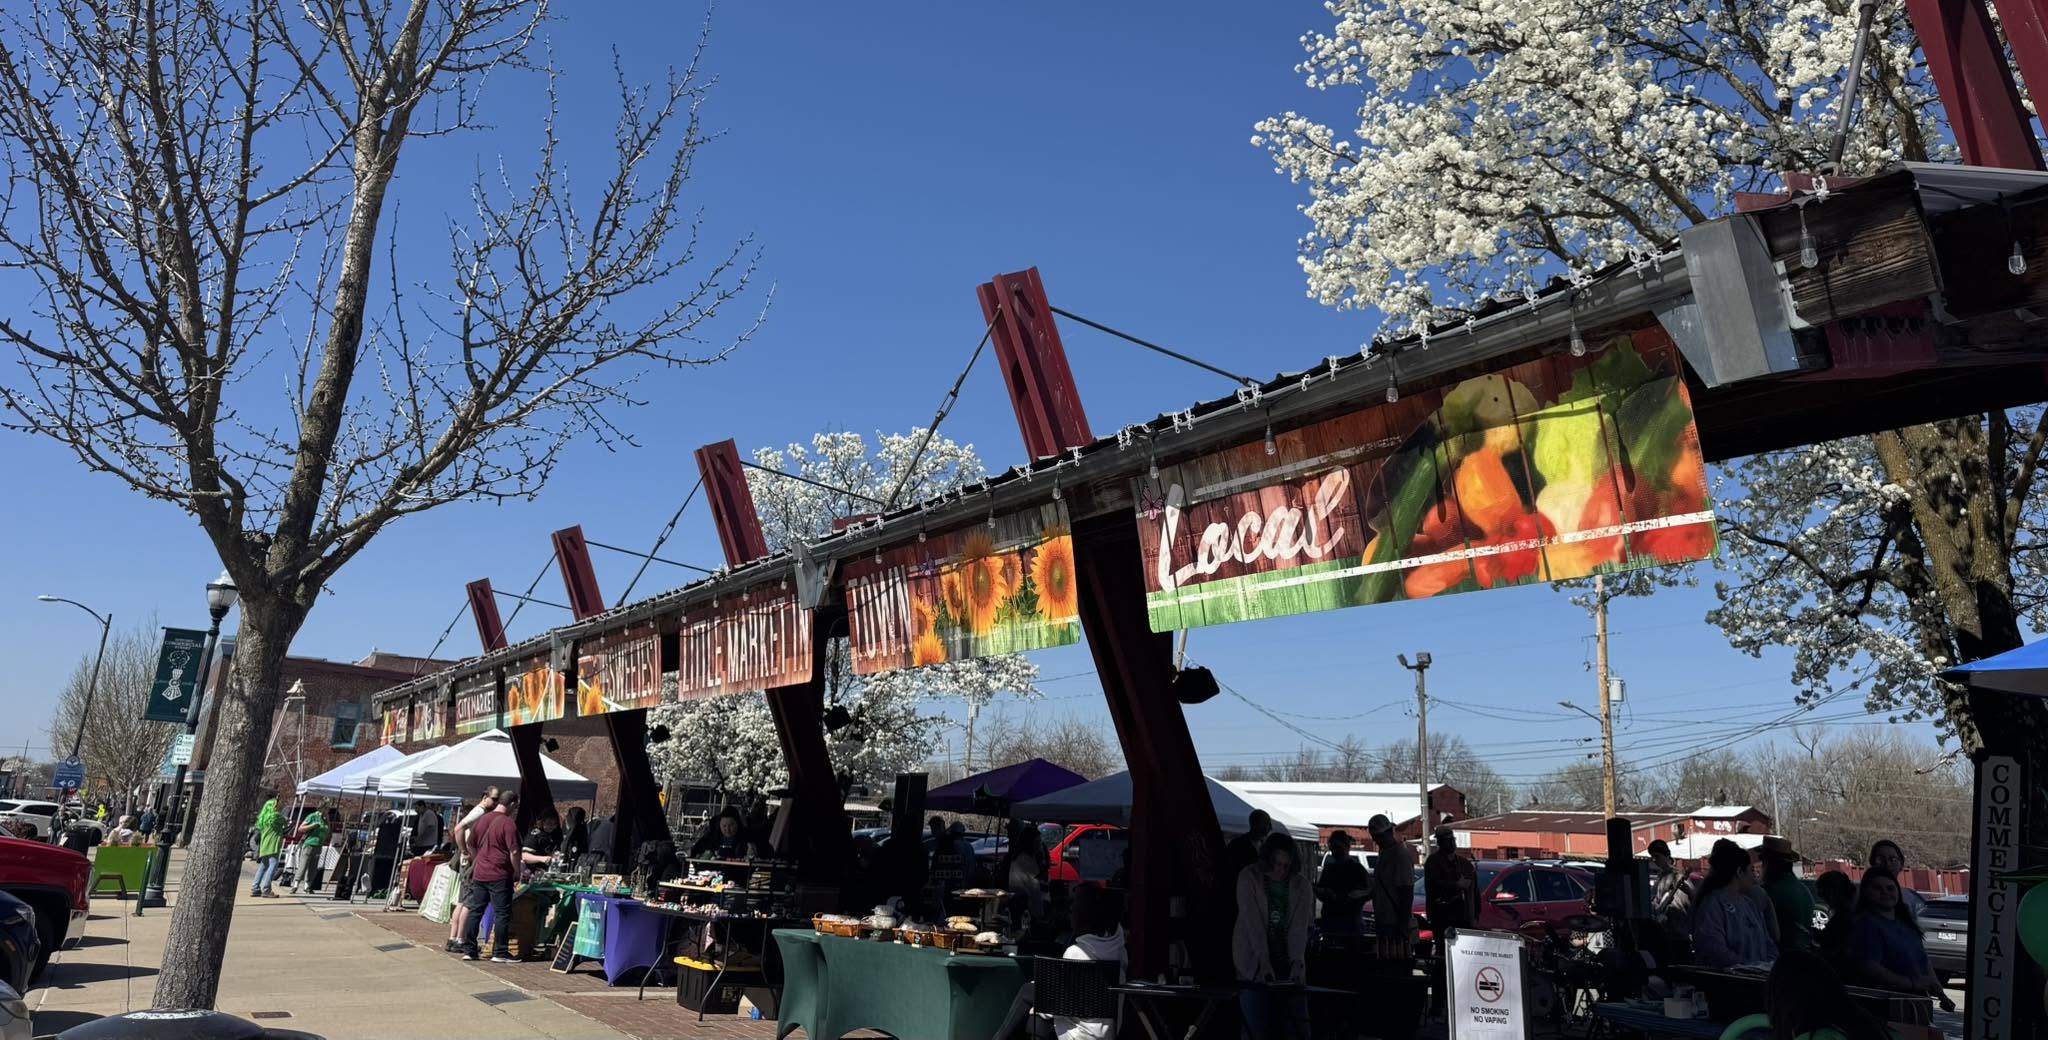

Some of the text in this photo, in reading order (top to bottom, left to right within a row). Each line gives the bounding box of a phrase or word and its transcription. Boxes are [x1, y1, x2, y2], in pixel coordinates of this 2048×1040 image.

[1157, 465, 1350, 593] Local
[682, 614, 722, 692] LITTLE
[726, 596, 786, 684] MARKET
[791, 593, 811, 673] IN
[847, 565, 912, 661] TOWN
[471, 690, 495, 716] MARKET
[608, 634, 660, 703] SWEETEST
[1470, 1006, 1509, 1016] NO SMOKING
[1474, 1015, 1507, 1025] NO VAPING
